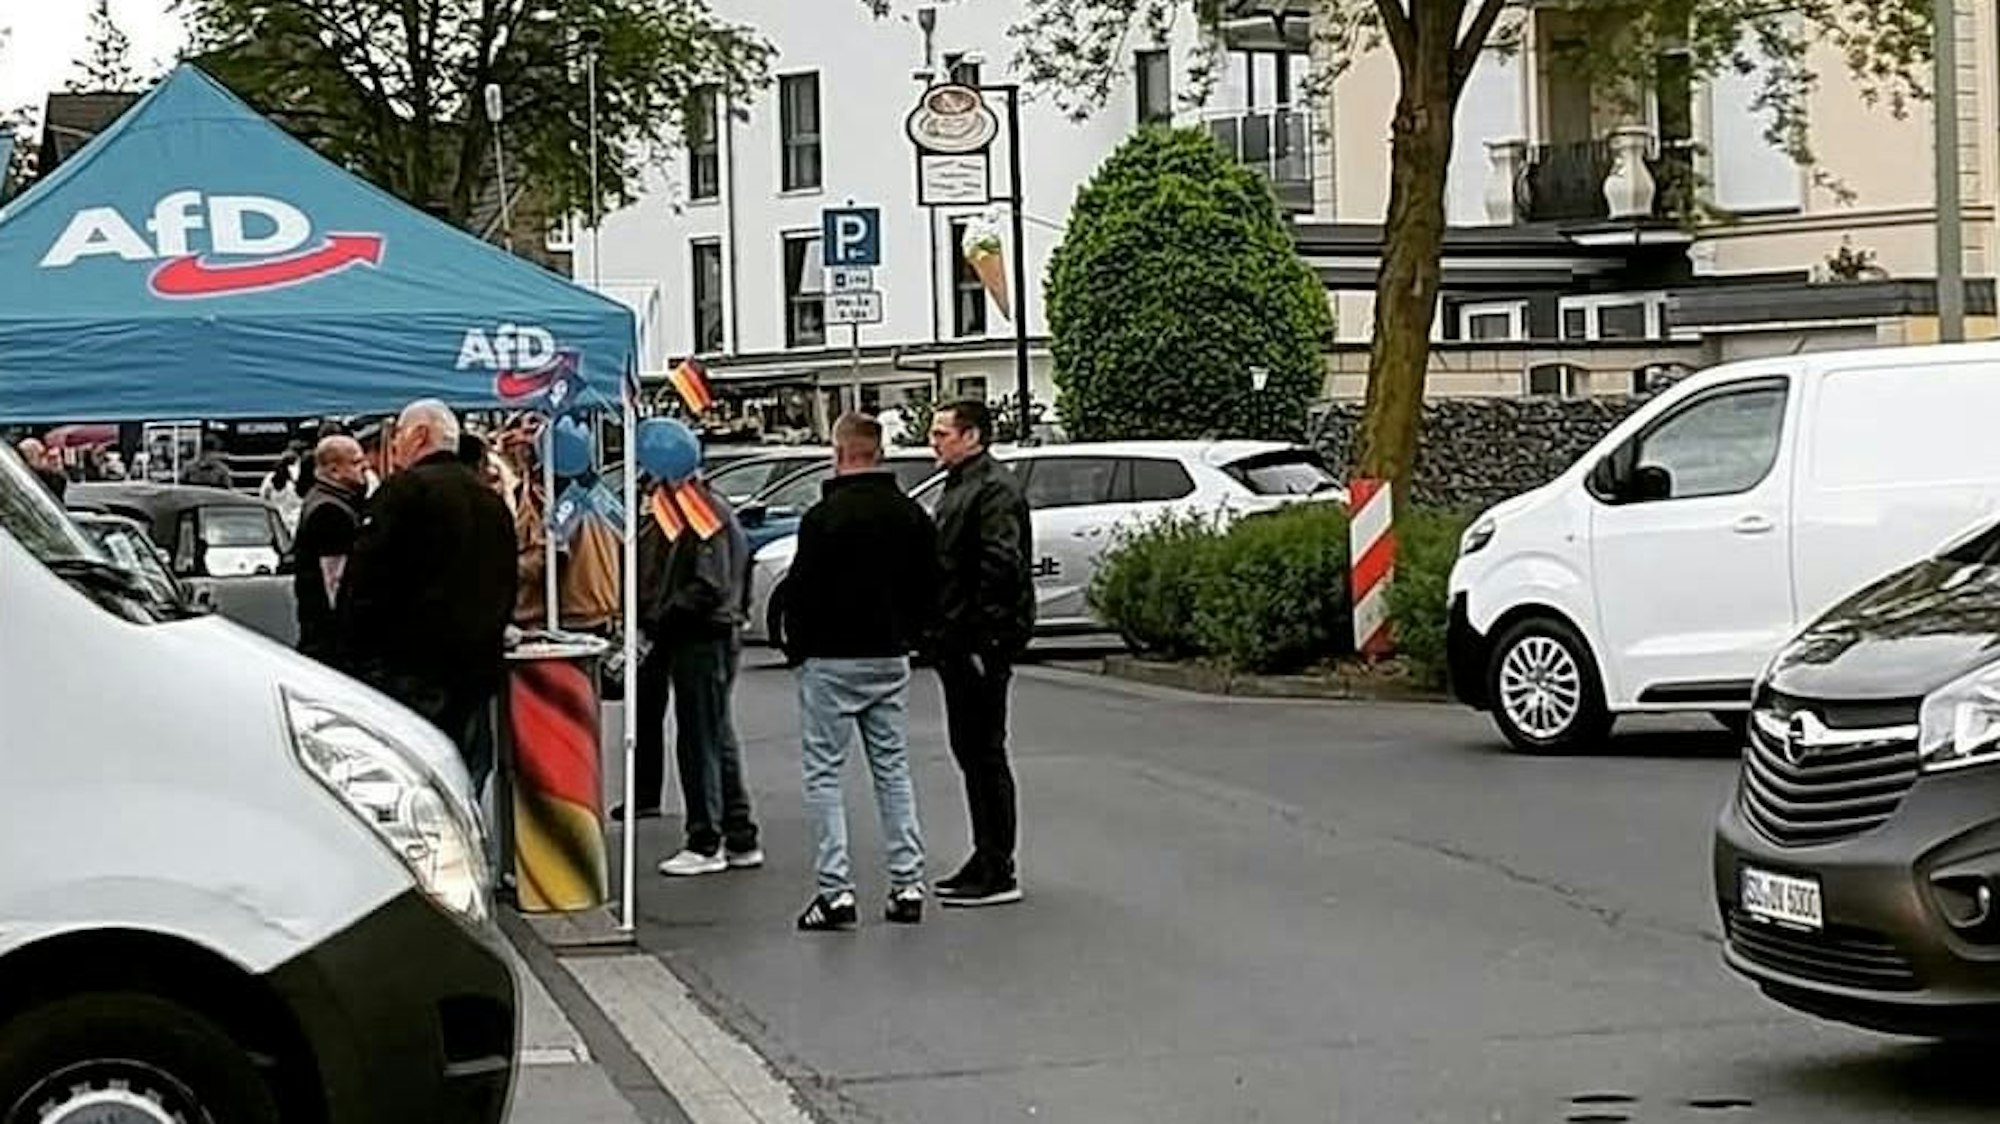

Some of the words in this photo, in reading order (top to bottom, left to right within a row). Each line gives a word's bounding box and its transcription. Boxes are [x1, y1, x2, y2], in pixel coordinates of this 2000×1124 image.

[39, 190, 312, 268] AfD
[836, 215, 867, 261] P
[456, 323, 555, 370] AfD
